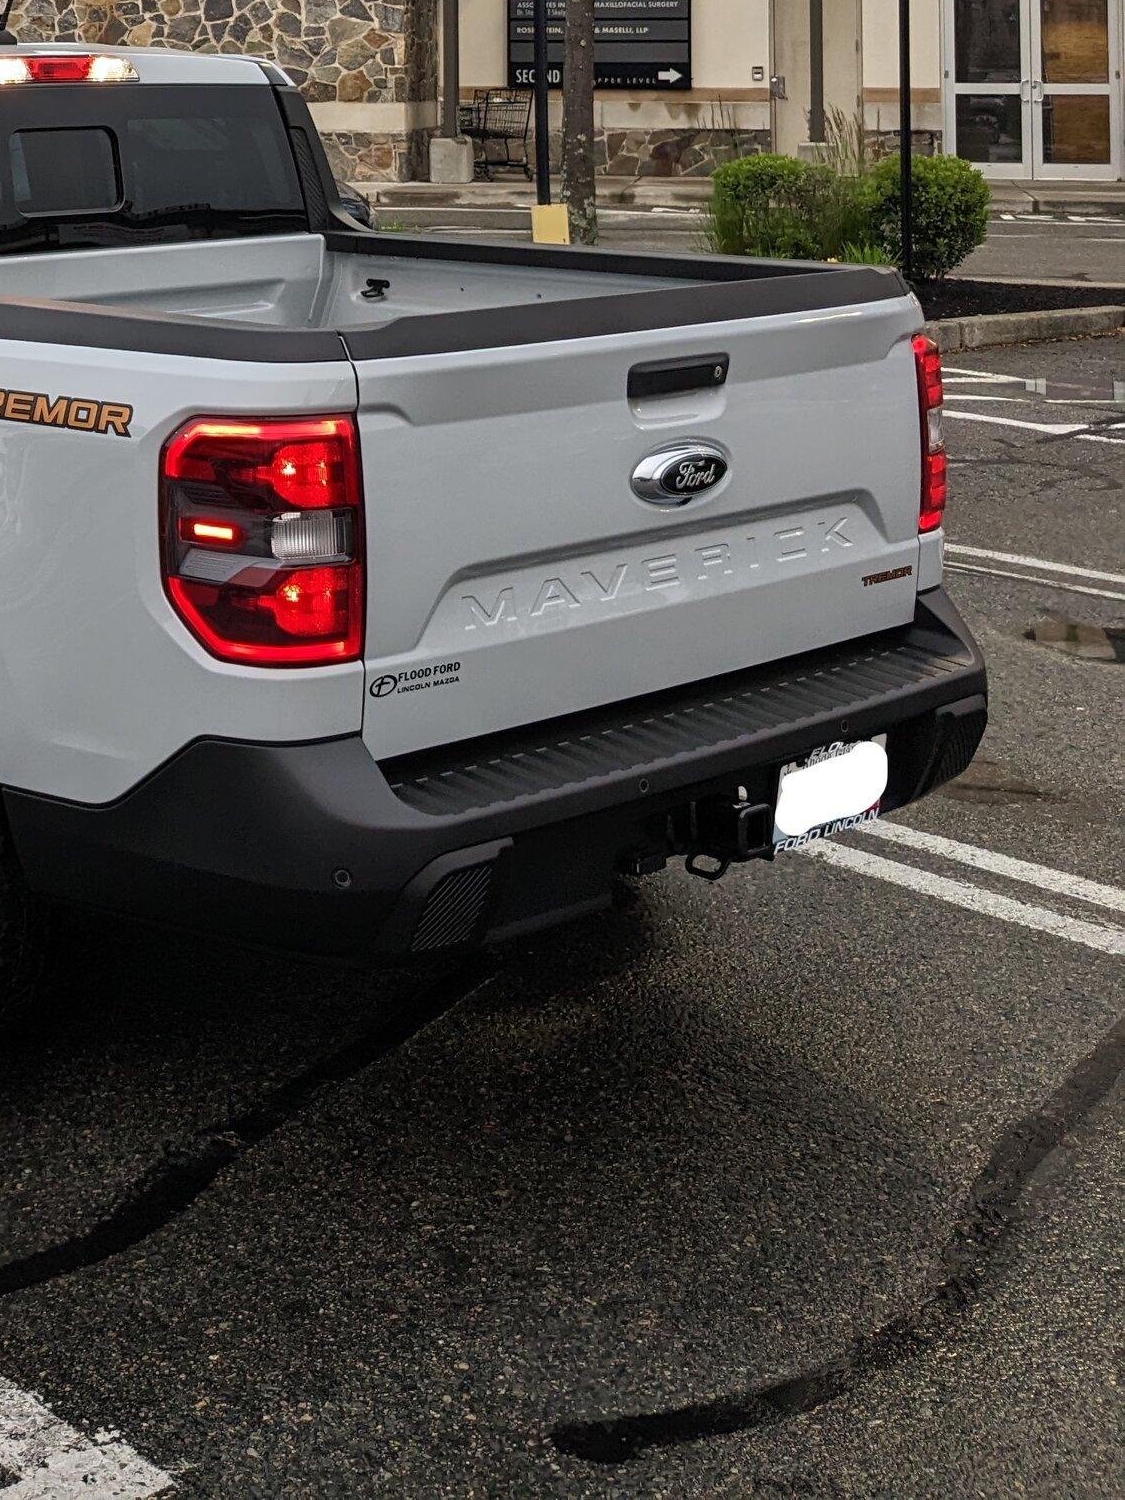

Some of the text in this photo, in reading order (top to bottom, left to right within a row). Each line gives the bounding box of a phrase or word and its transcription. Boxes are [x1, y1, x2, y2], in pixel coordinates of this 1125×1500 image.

[648, 0, 679, 8] SURGERY
[602, 26, 635, 34] MASELLI,
[515, 69, 560, 83] SECND
[626, 76, 657, 84] LEVEL
[675, 460, 717, 490] Ford
[460, 515, 854, 631] MAVERICK
[861, 565, 913, 587] TREMOR
[397, 661, 461, 682] FLOOD FORD
[397, 676, 460, 694] LINCOLN MAZDA
[775, 807, 880, 855] FORD LINCOLN
